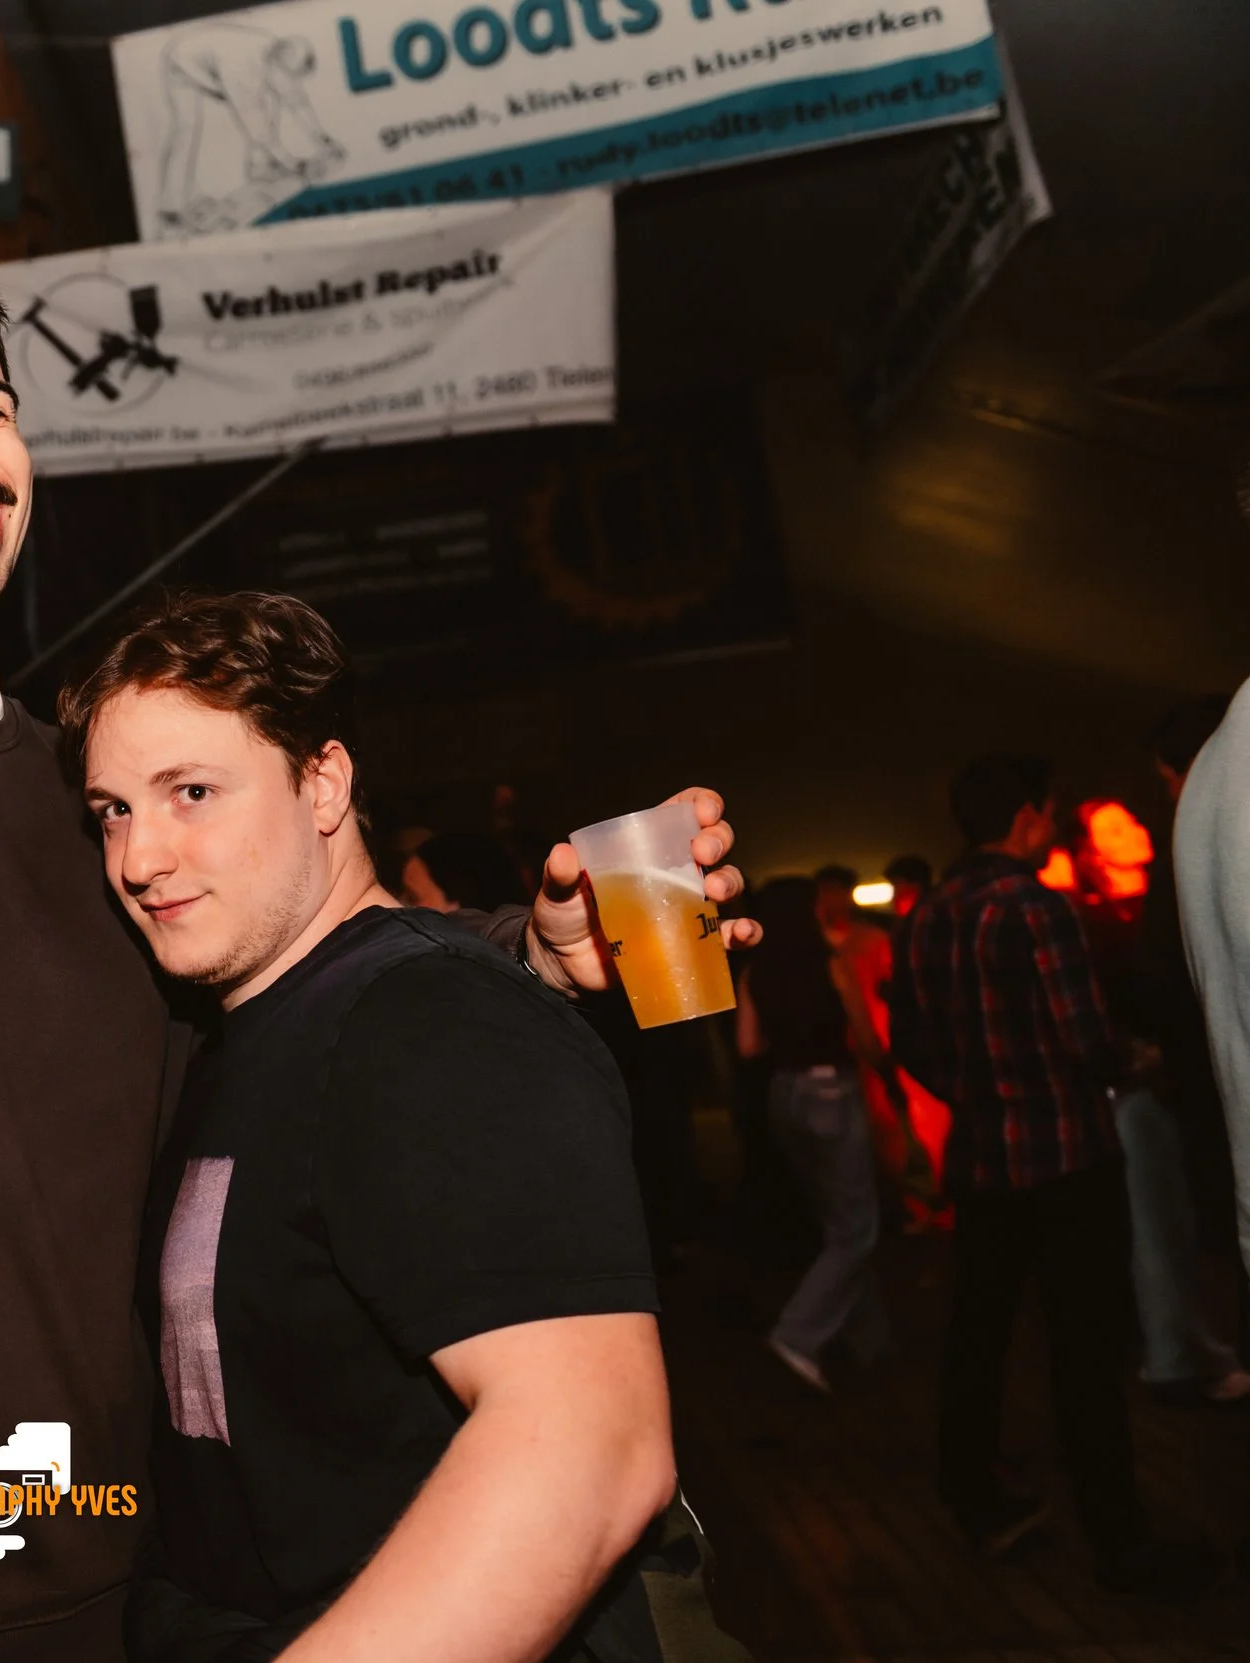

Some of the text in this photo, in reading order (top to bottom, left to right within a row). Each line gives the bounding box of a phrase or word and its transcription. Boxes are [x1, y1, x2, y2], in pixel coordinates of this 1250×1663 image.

[507, 74, 638, 118] klinker-
[645, 65, 687, 89] en
[693, 4, 944, 79] klusjeswerken
[486, 163, 526, 191] 41
[557, 67, 985, 176] rudy.loodts@telenet.be
[201, 248, 503, 322] Verhulst Repair
